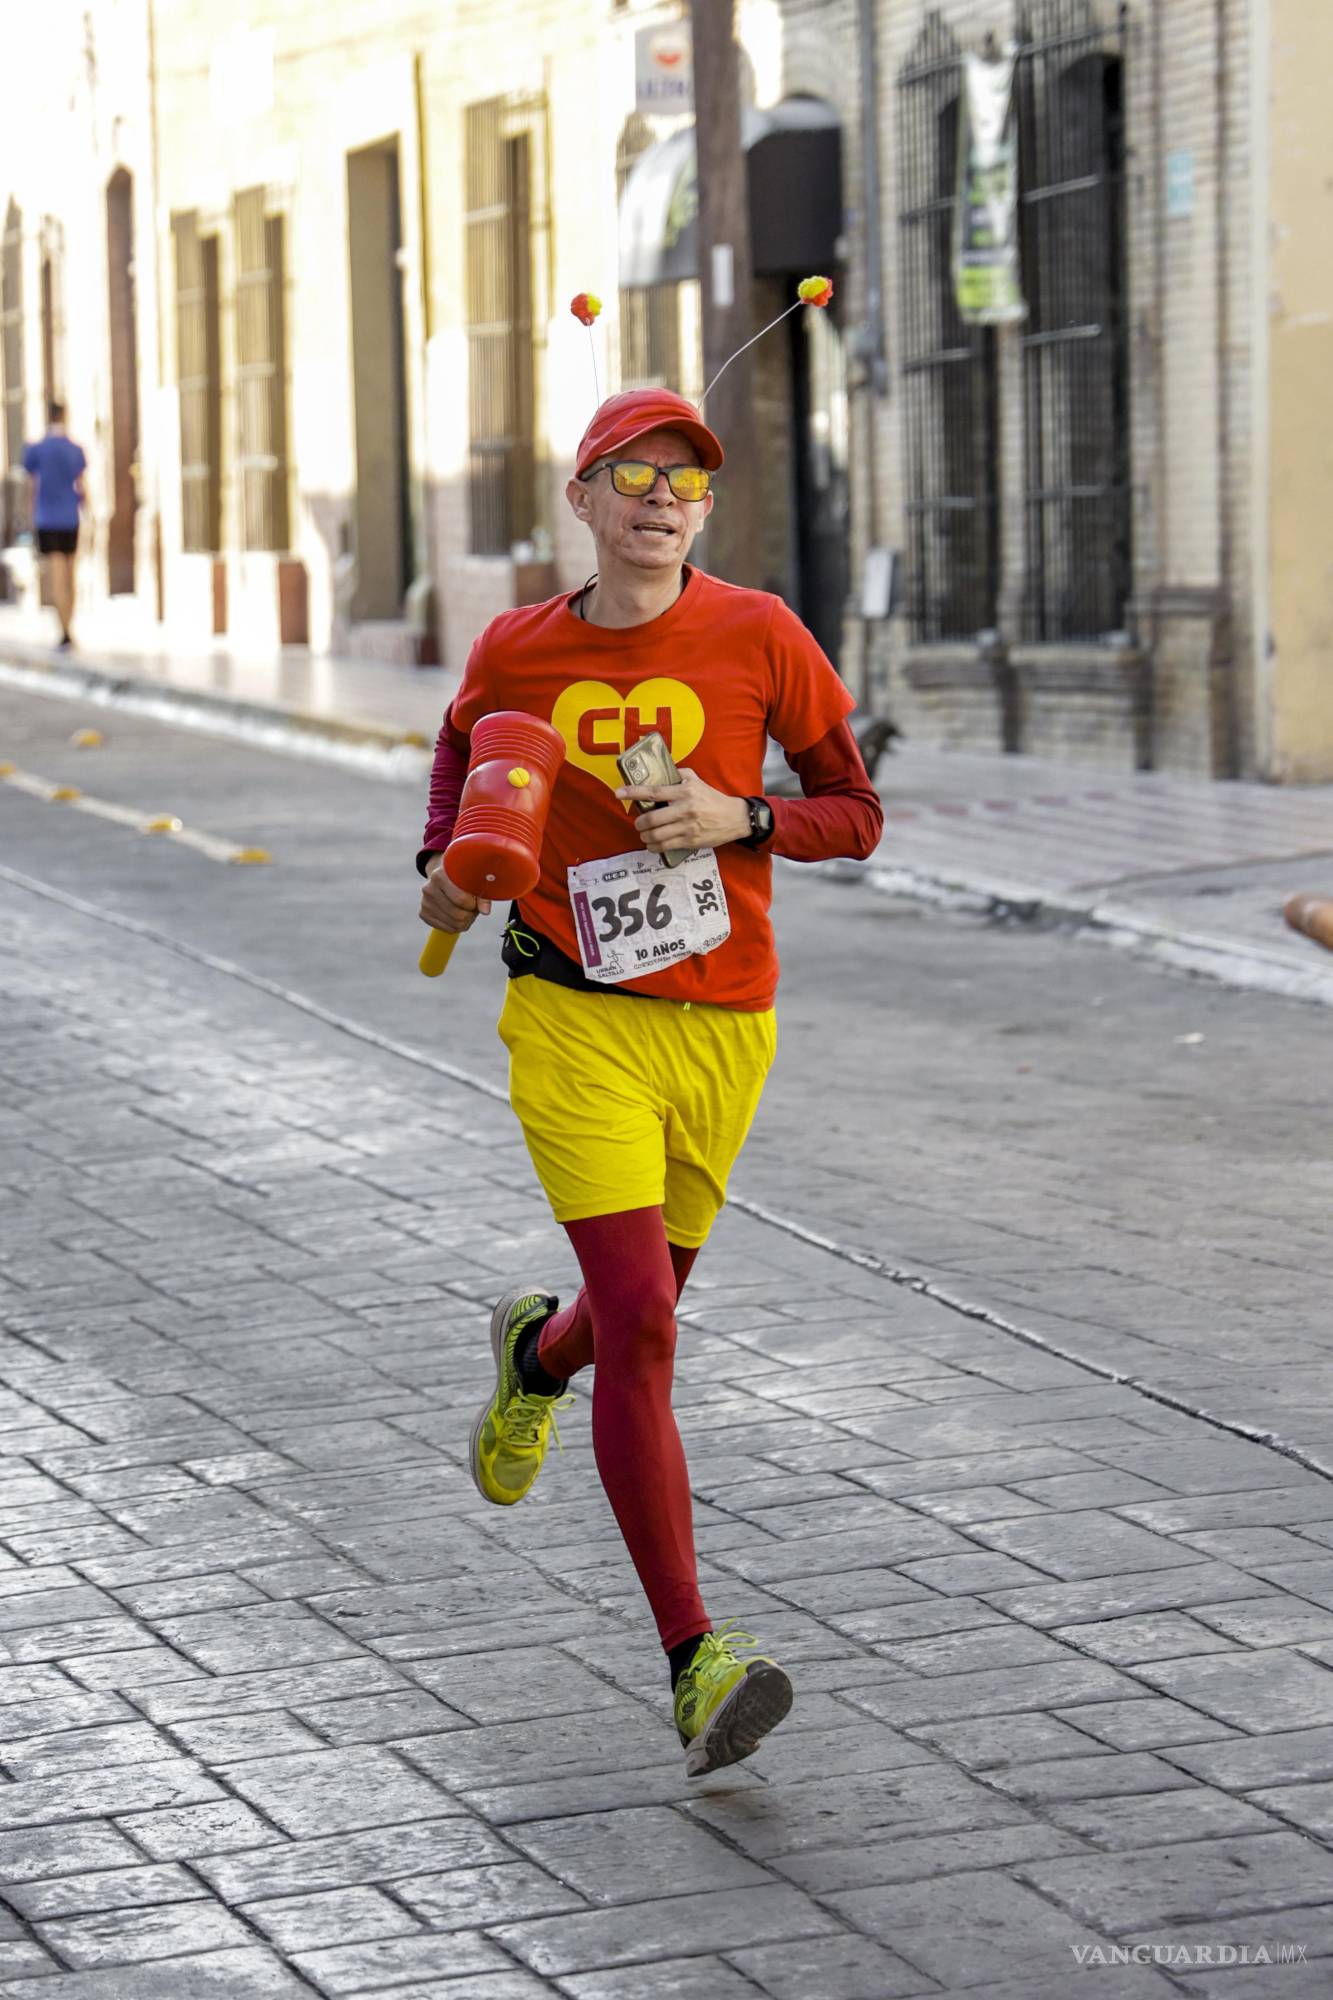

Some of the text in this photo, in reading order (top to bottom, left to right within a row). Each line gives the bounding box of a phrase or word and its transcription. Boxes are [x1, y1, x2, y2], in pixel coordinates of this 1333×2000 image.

[578, 707, 672, 756] CH
[591, 883, 672, 943] 356
[692, 878, 719, 916] 356
[635, 949, 648, 961] 10
[653, 939, 686, 957] AÑOS
